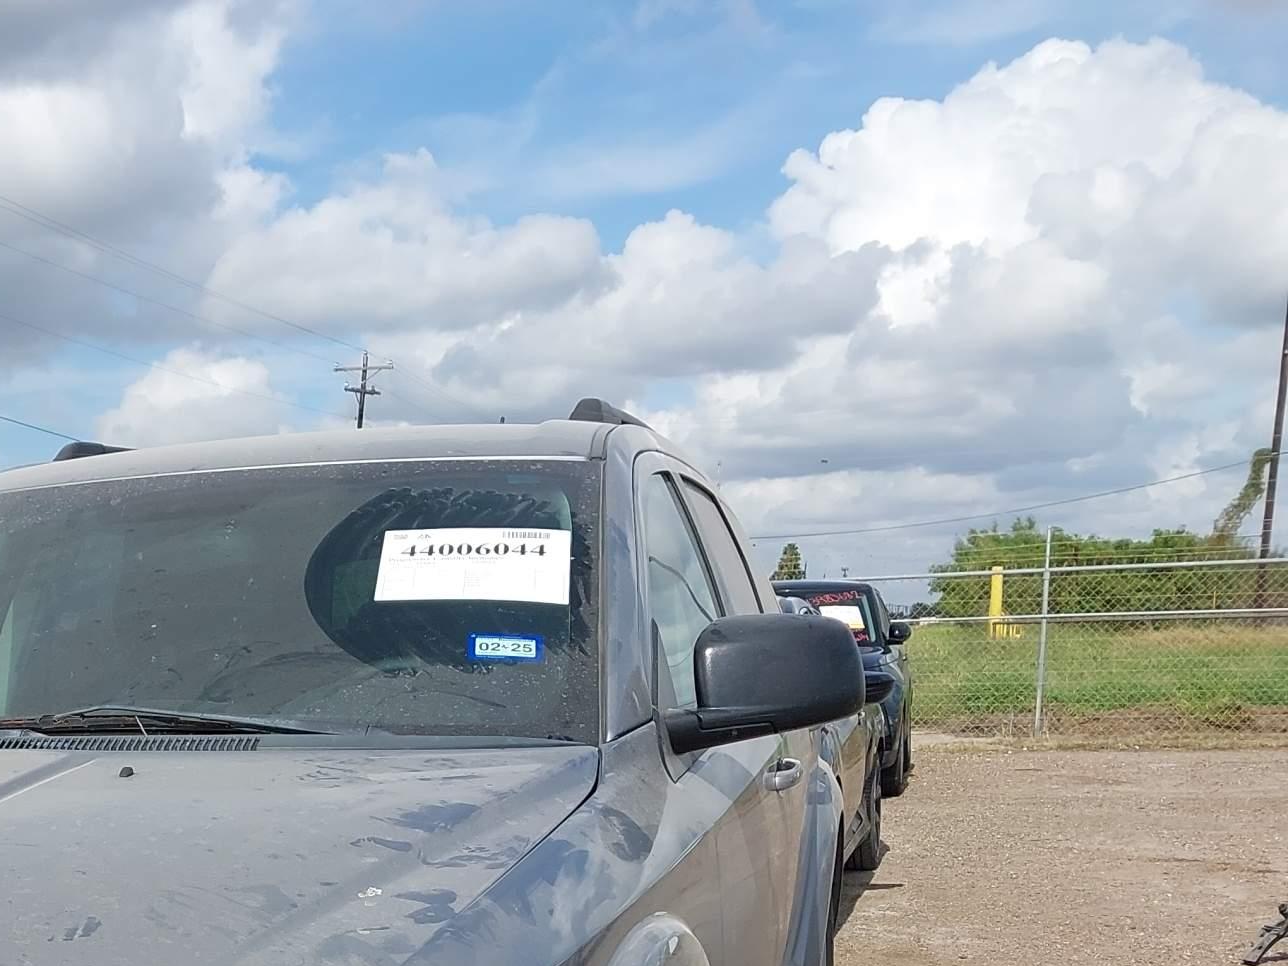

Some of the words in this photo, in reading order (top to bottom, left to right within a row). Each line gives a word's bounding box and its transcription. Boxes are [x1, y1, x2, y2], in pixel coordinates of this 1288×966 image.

[400, 542, 546, 557] 44006044
[478, 642, 501, 652] 02
[510, 643, 533, 653] 25
